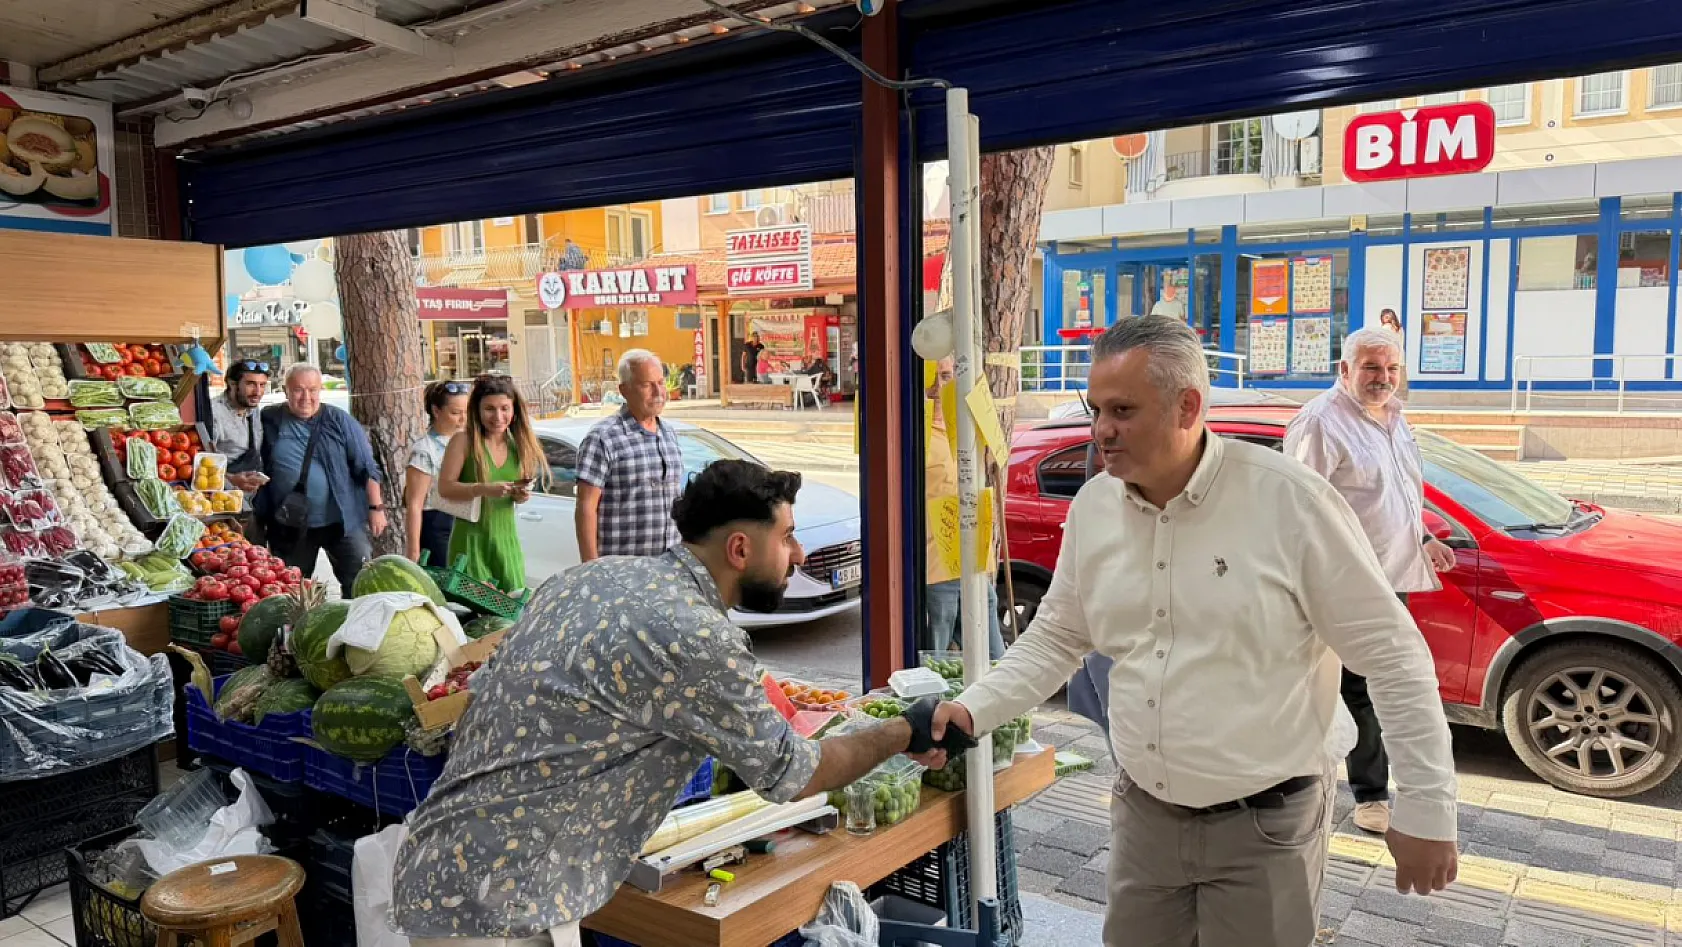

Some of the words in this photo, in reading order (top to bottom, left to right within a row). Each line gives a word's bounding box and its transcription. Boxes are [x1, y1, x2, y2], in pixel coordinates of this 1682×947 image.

[1356, 109, 1477, 170] BİM
[731, 229, 801, 251] TATLISES
[568, 268, 649, 295] KARVA
[655, 267, 688, 292] ET
[756, 264, 795, 283] KÖFTE
[422, 299, 442, 311] TAŞ
